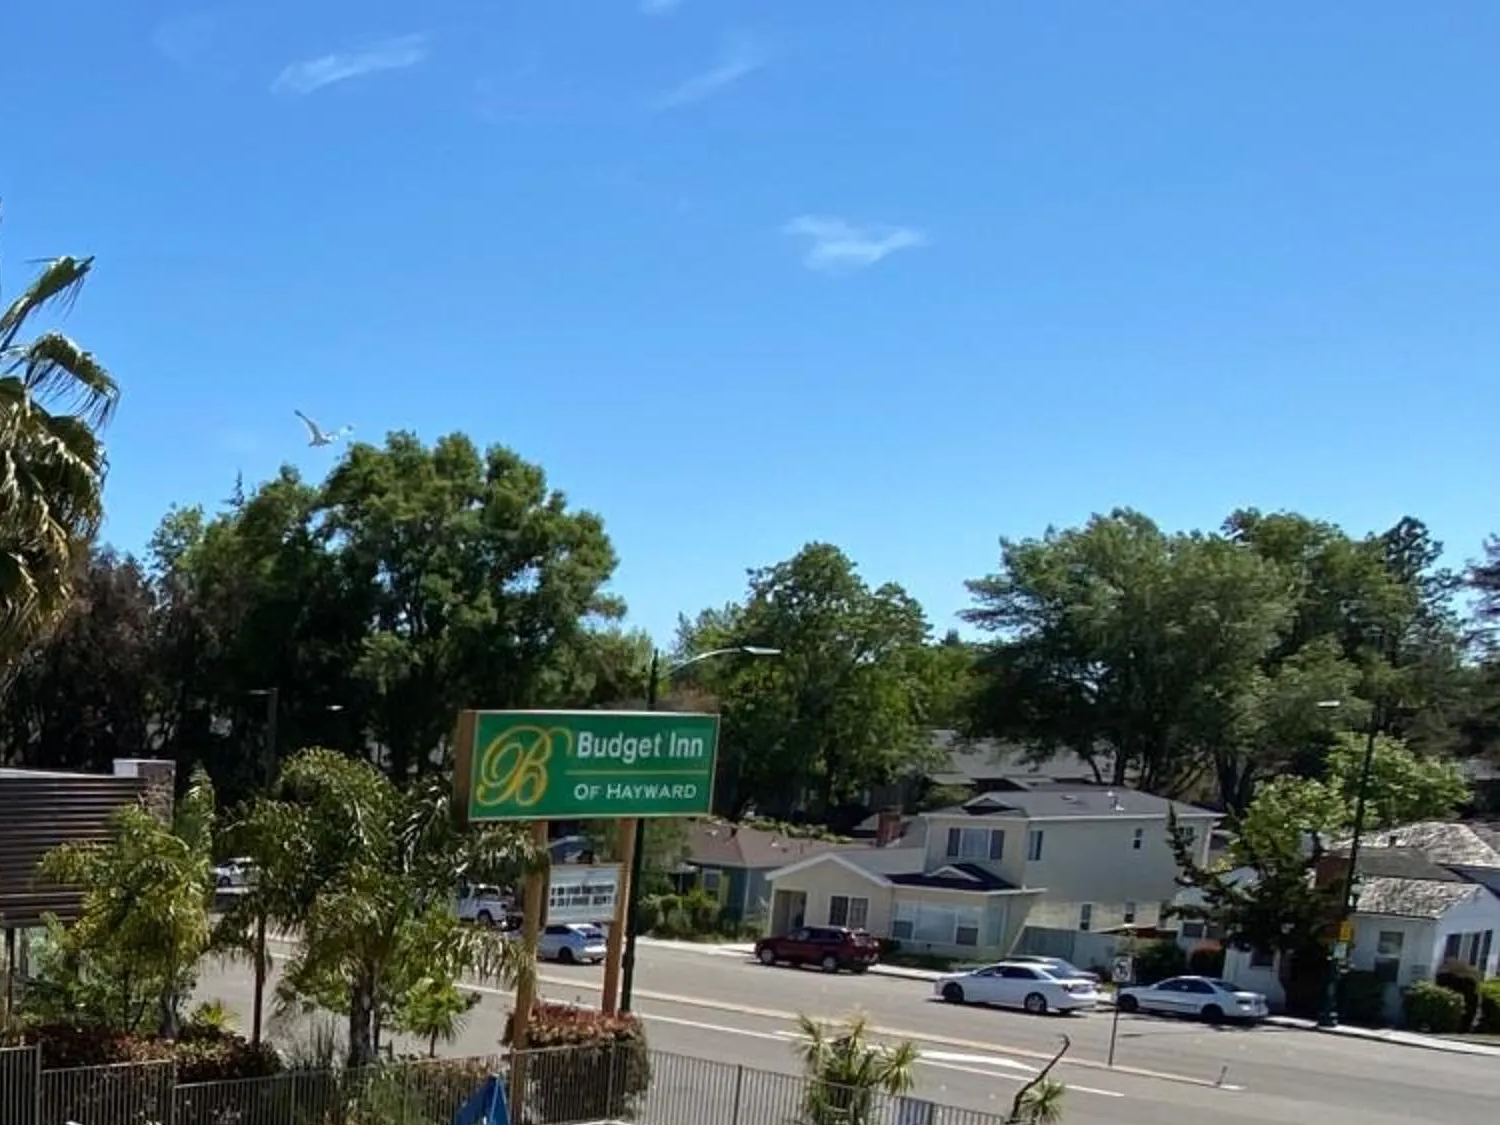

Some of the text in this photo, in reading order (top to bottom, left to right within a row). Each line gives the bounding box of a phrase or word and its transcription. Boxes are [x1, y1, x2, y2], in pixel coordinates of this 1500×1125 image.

[577, 731, 703, 763] Budget Inn
[574, 783, 697, 800] OF HAYWARD
